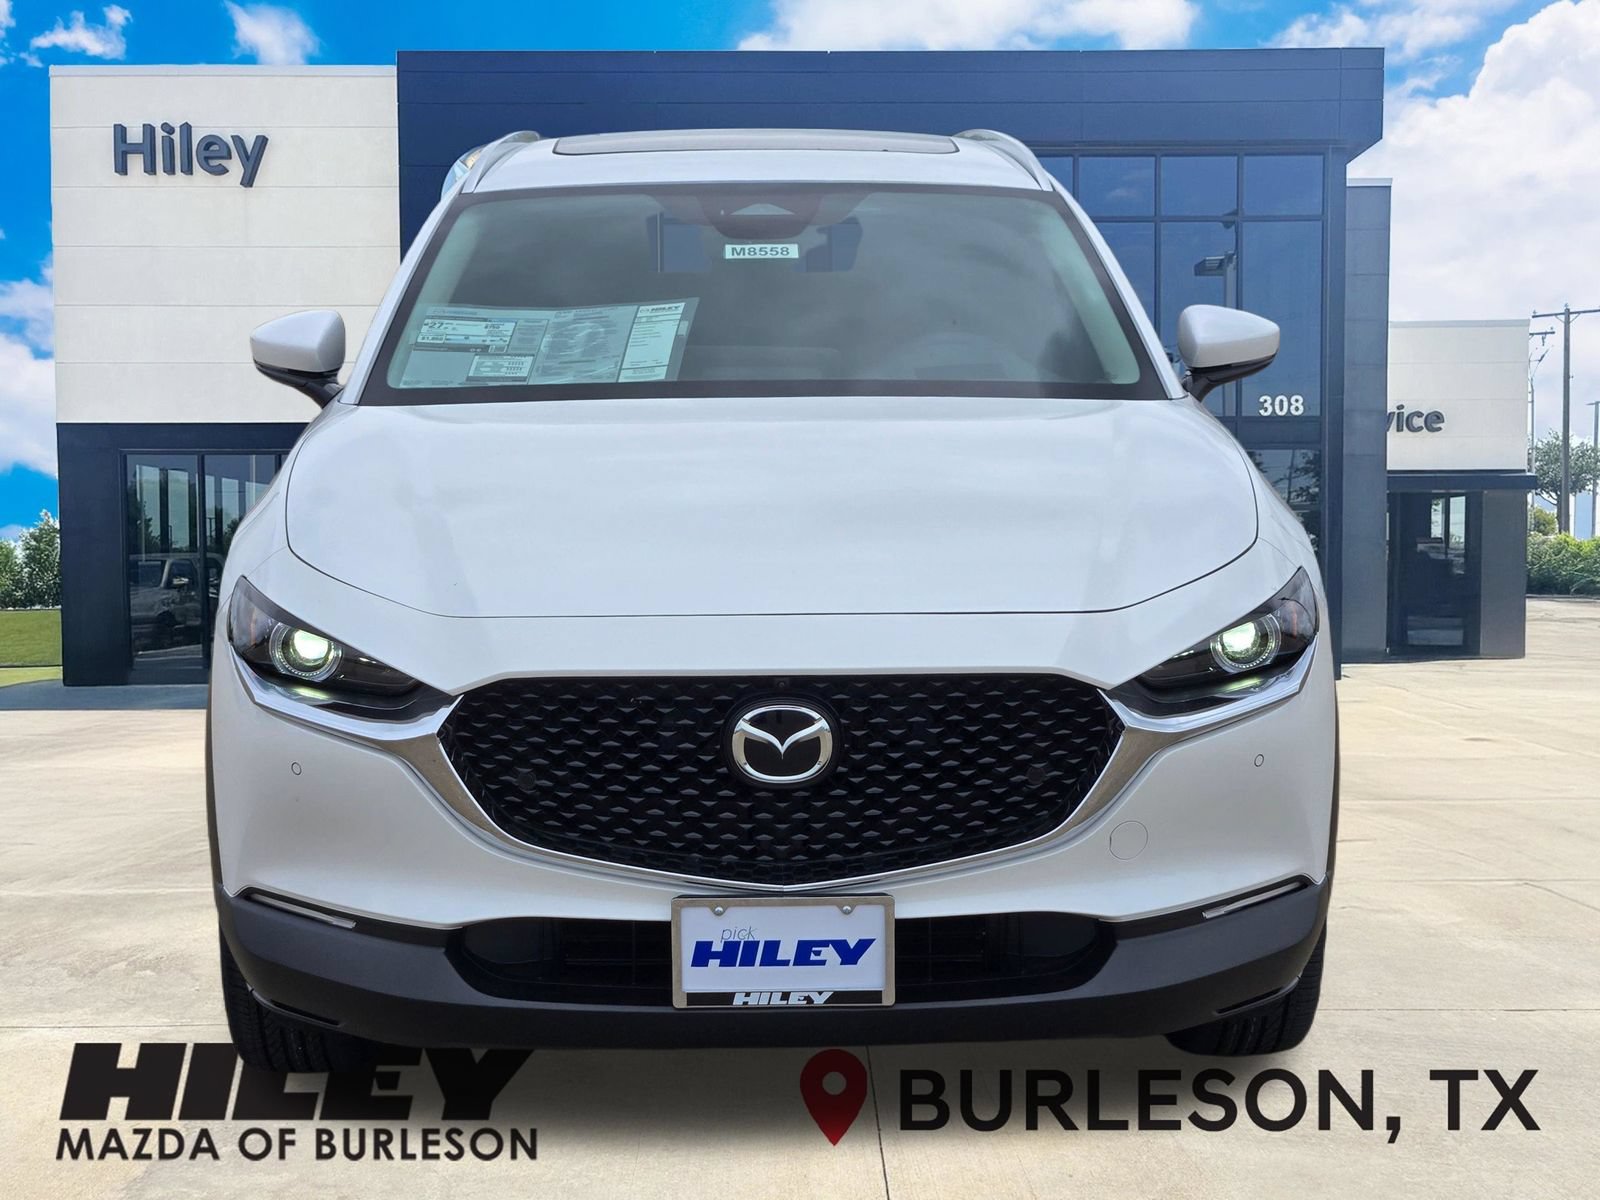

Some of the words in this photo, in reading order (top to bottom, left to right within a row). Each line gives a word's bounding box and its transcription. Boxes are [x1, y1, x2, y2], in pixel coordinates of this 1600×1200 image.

[113, 121, 269, 188] Hiley
[731, 246, 791, 257] M8558
[1258, 394, 1304, 417] 308
[720, 926, 758, 943] pick
[690, 938, 877, 968] HILEY
[732, 991, 834, 1006] HILEY
